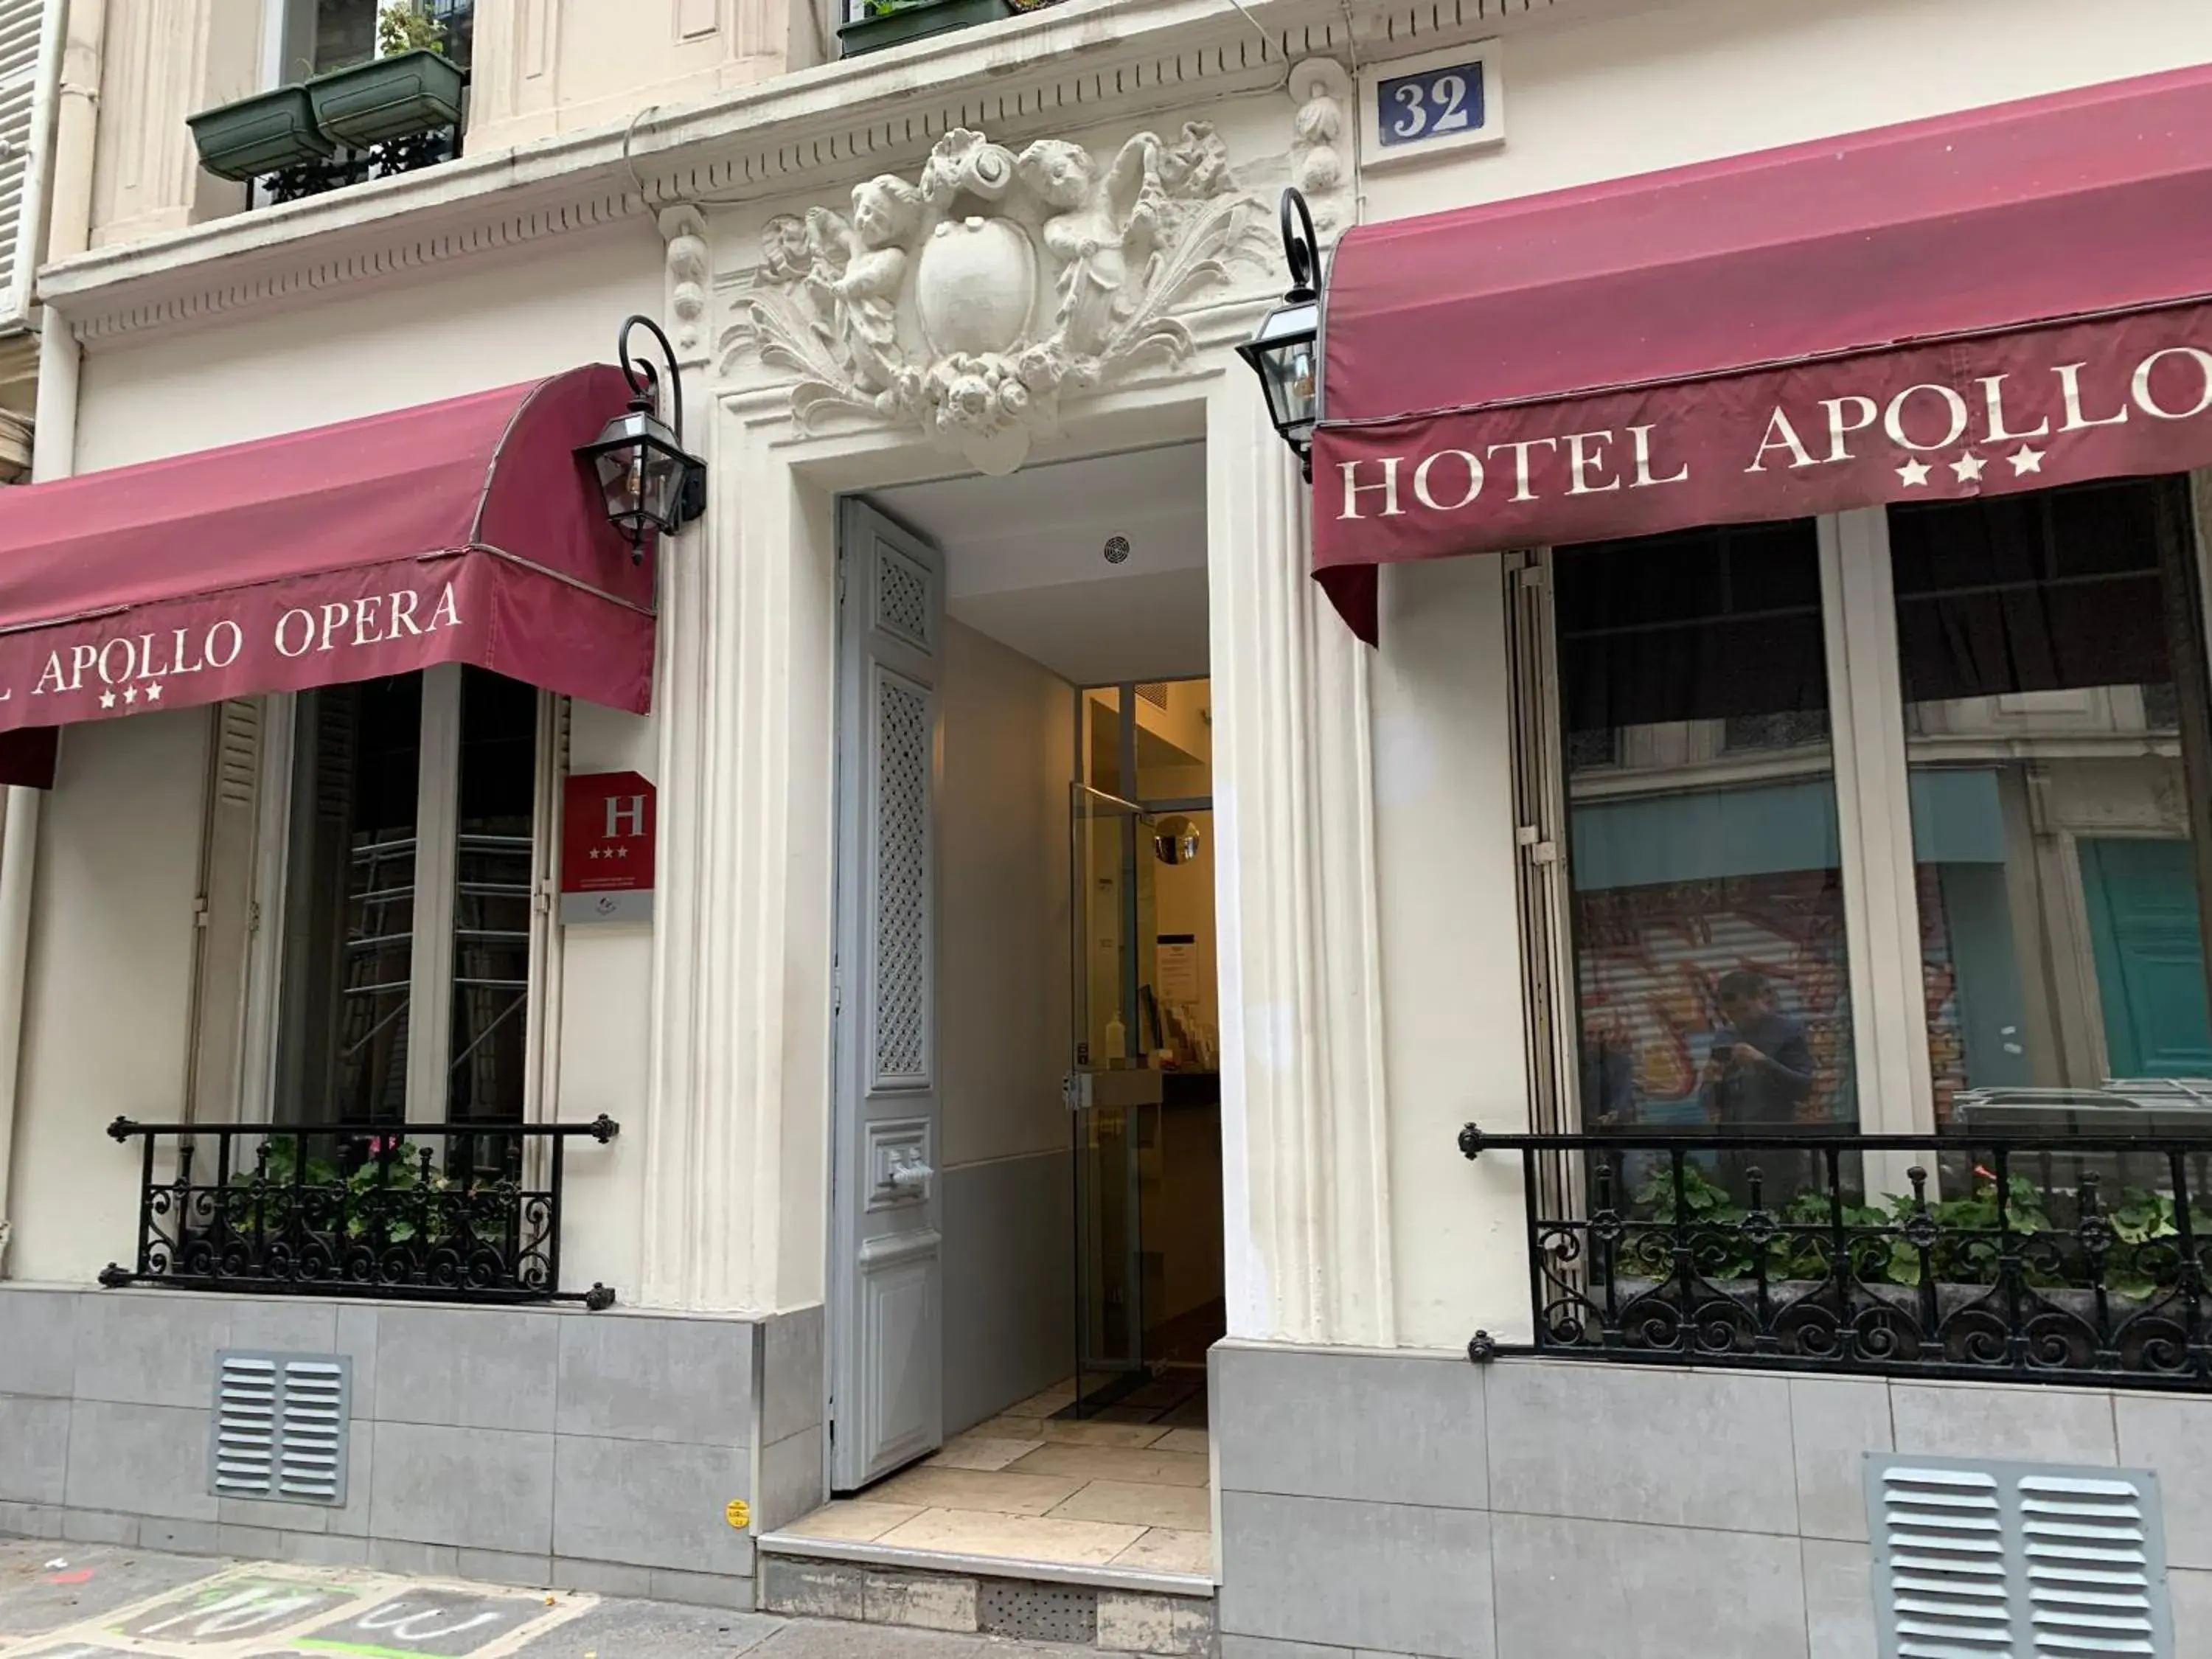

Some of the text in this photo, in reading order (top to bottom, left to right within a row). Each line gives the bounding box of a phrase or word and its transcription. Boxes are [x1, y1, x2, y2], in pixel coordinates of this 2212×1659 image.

[1394, 76, 1468, 137] 32
[1335, 347, 2212, 521] HOTEL APOLLO
[30, 580, 463, 695] APOLLO OPERA
[601, 794, 647, 838] H
